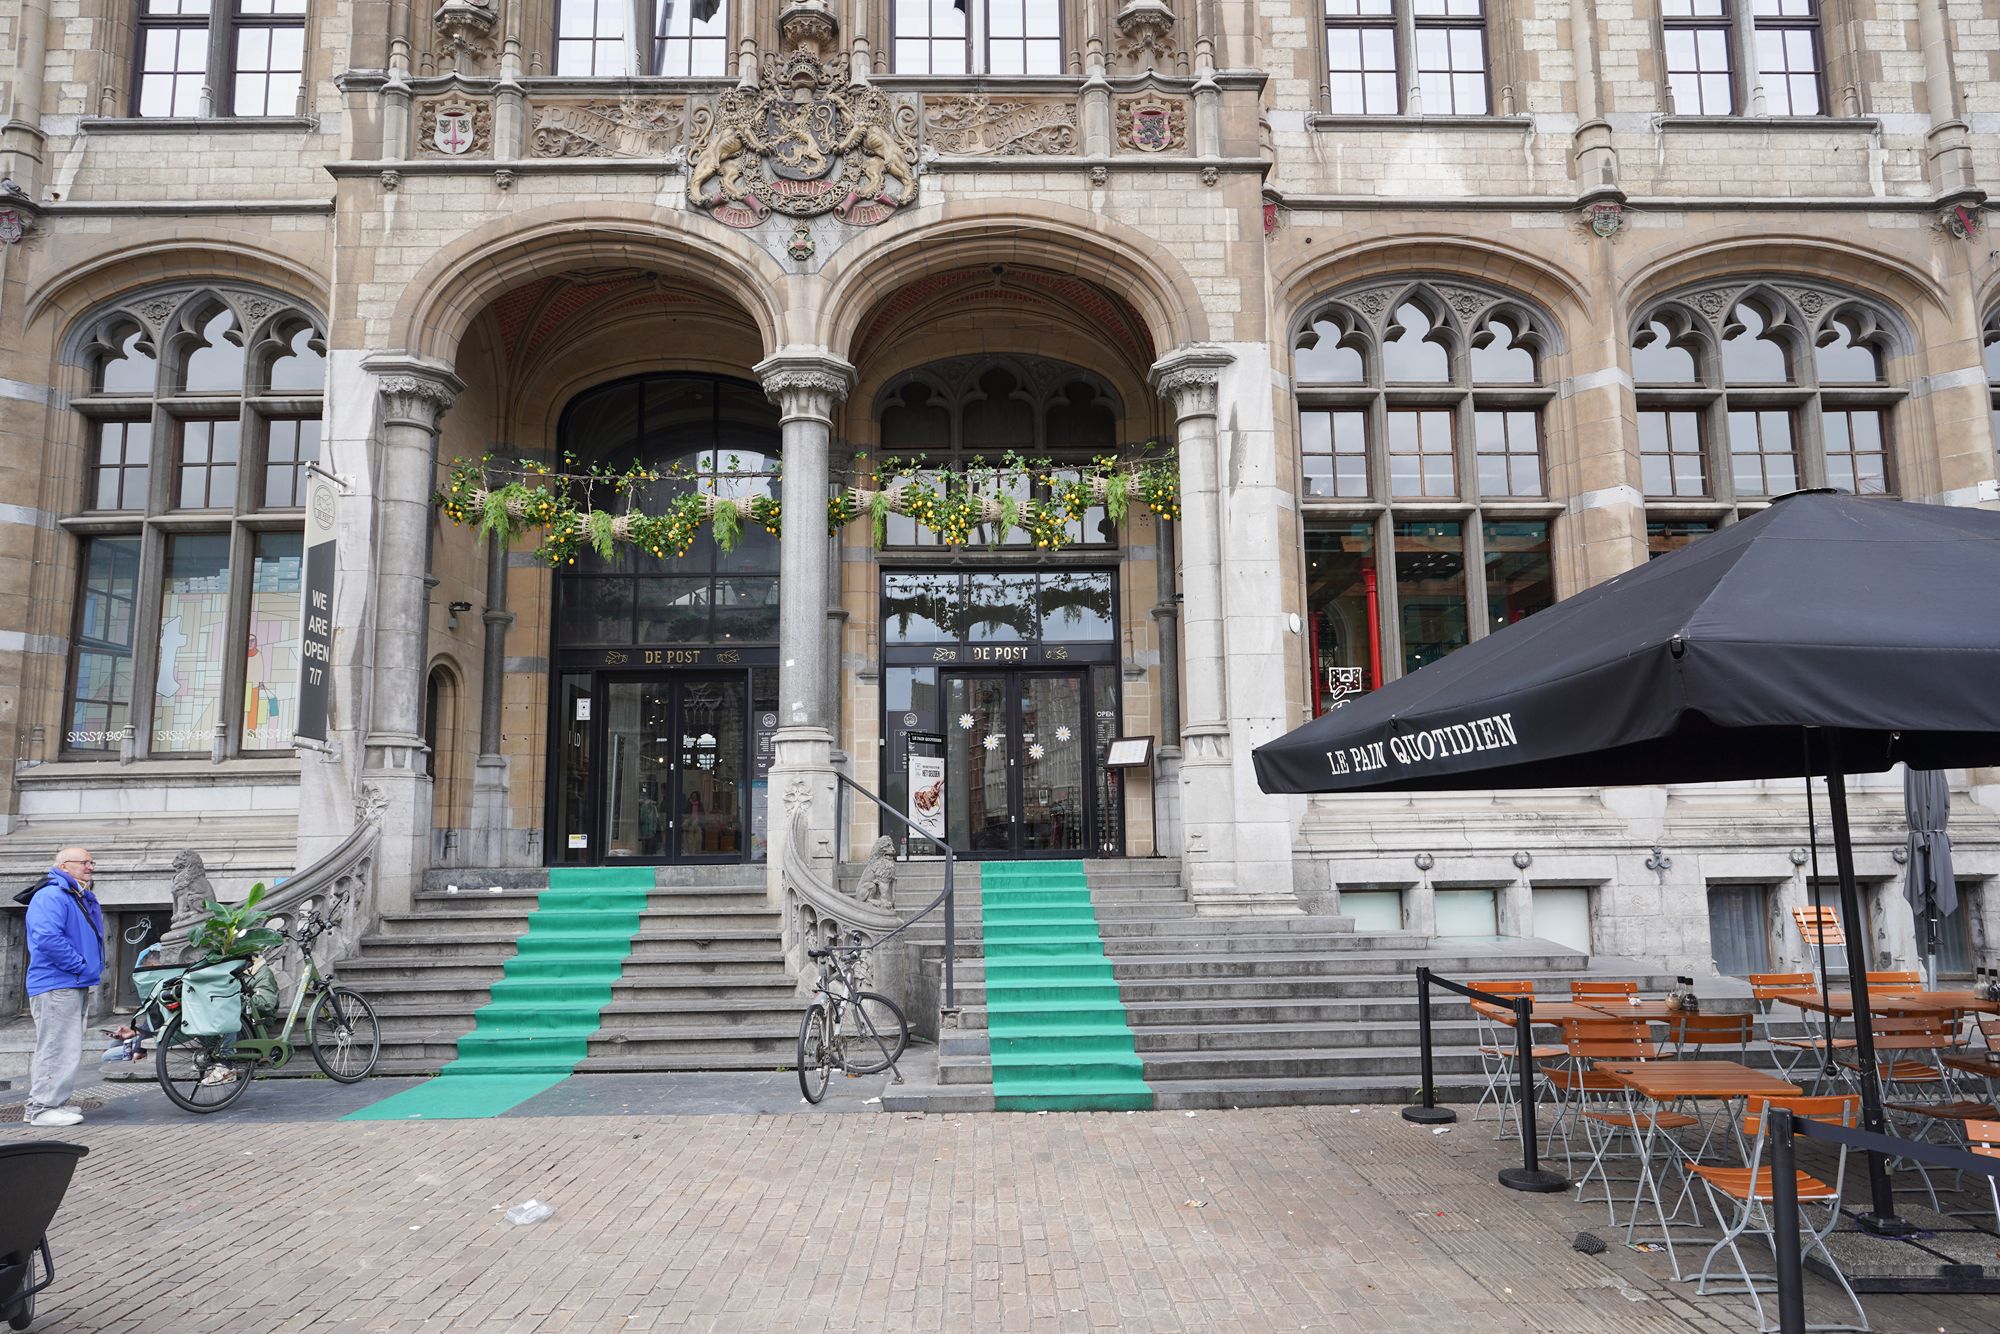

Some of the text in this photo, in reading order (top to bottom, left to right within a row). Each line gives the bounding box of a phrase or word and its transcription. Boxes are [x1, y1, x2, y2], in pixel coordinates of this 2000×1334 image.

[312, 589, 327, 611] WE
[308, 615, 328, 637] ARE
[304, 639, 330, 663] OPEN
[645, 650, 700, 664] DE POST
[972, 647, 1028, 660] DE POST
[309, 667, 323, 686] 7/7
[1326, 713, 1517, 775] LE PAIN QUOTIDIEN
